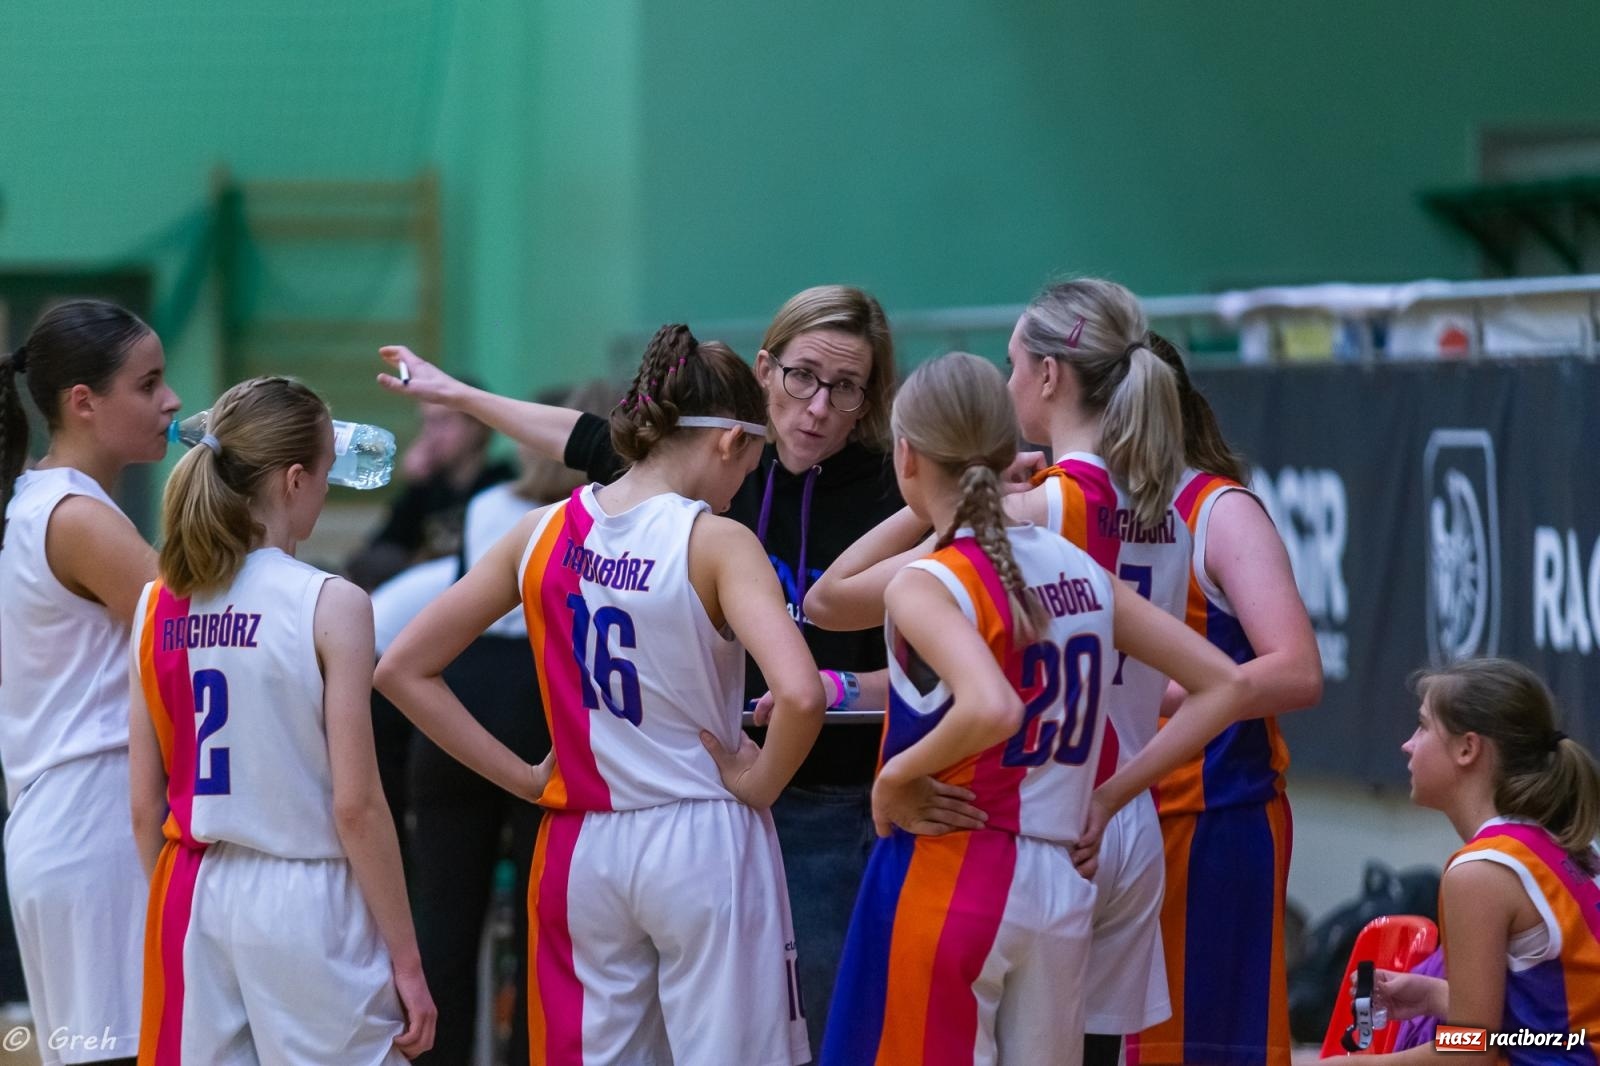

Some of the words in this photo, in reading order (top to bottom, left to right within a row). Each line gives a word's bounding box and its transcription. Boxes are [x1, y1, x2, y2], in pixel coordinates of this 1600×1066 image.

[162, 605, 262, 652] RACIBÓRZ
[1027, 571, 1104, 618] IBÓRZ
[567, 592, 643, 727] 16
[1002, 633, 1102, 767] 20
[193, 668, 231, 796] 2
